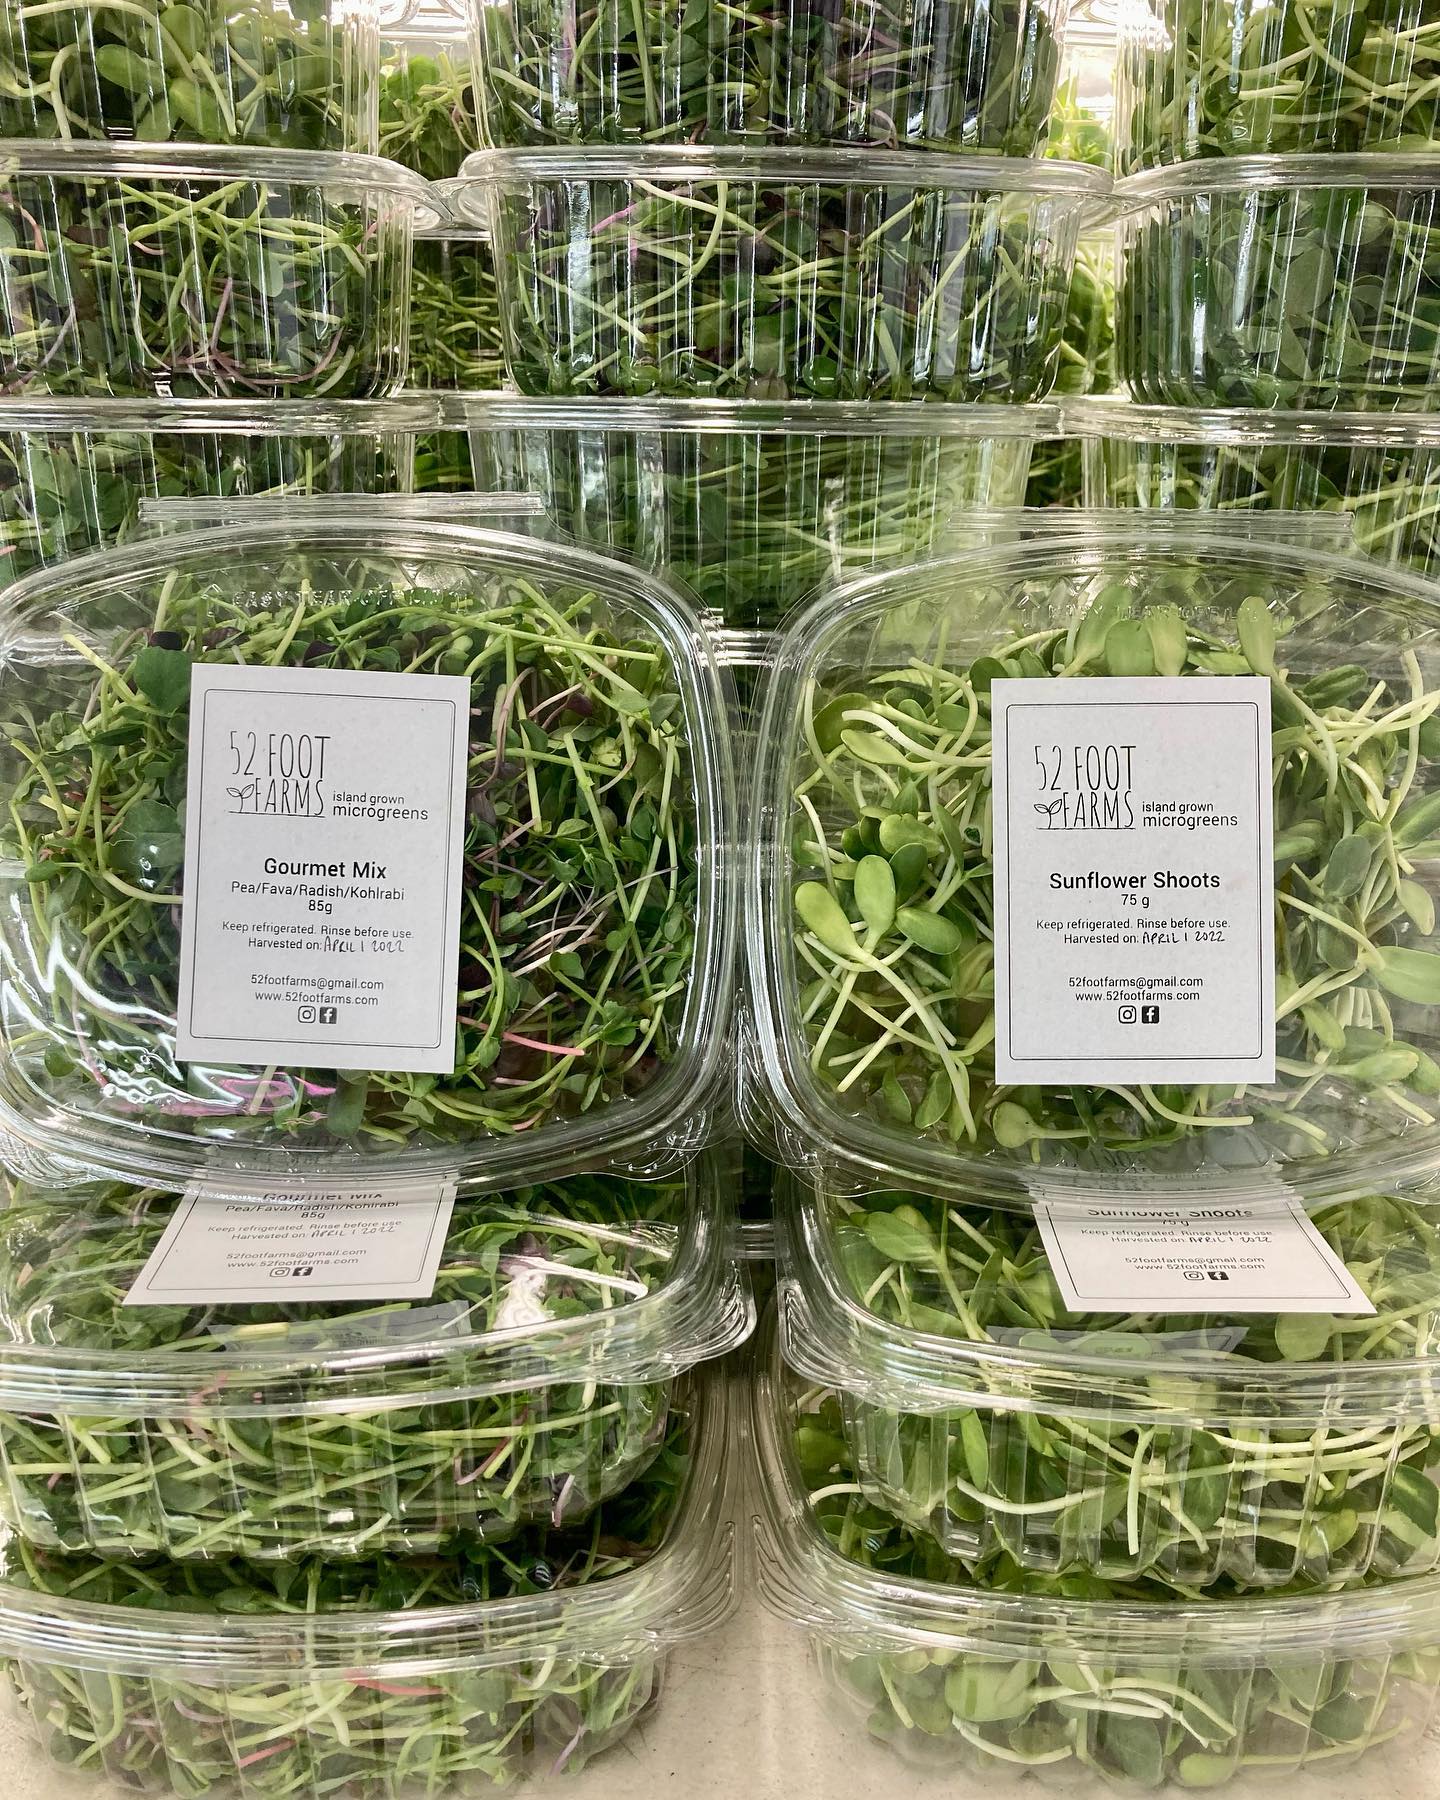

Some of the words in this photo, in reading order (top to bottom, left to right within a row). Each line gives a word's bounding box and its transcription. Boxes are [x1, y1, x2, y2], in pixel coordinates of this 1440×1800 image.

[230, 731, 255, 776] 52
[269, 734, 330, 779] FOOT
[1035, 746, 1062, 791] 52
[1075, 746, 1136, 791] FOOT
[255, 779, 323, 816] FARMS
[333, 791, 366, 803] island
[370, 794, 404, 805] grown
[333, 804, 428, 821] microgreens
[1063, 791, 1134, 828] FARMS
[1143, 801, 1175, 812] island
[1180, 803, 1213, 814] grown
[1143, 813, 1238, 829] microgreens
[264, 858, 345, 878] Gourmet
[353, 862, 387, 879] Mix
[1050, 871, 1146, 889] Sunflower
[1154, 871, 1220, 888] Shoots
[232, 881, 404, 900] Pea/Fava/Radish/Kohlrabi
[309, 900, 332, 914] 85g
[1121, 895, 1137, 906] 75
[1142, 896, 1150, 908] g
[223, 922, 249, 935] Keep
[322, 926, 350, 936] Rinse
[355, 926, 389, 938] before
[1036, 919, 1063, 931] Keep
[1138, 918, 1167, 929] Rinse
[1171, 918, 1204, 929] before
[249, 938, 302, 950] Harvested
[324, 937, 356, 953] APRIL
[371, 941, 404, 953] 2022
[1064, 933, 1119, 944] Harvested
[1142, 932, 1180, 944] APRIL
[1195, 931, 1225, 942] 2022
[251, 975, 383, 991] 52footfarms@gmail.com
[1069, 976, 1203, 989] 52footfarms@gmail.com
[255, 991, 378, 1005] www.52footfarms.com
[1075, 990, 1200, 1002] www.52footfarms.com
